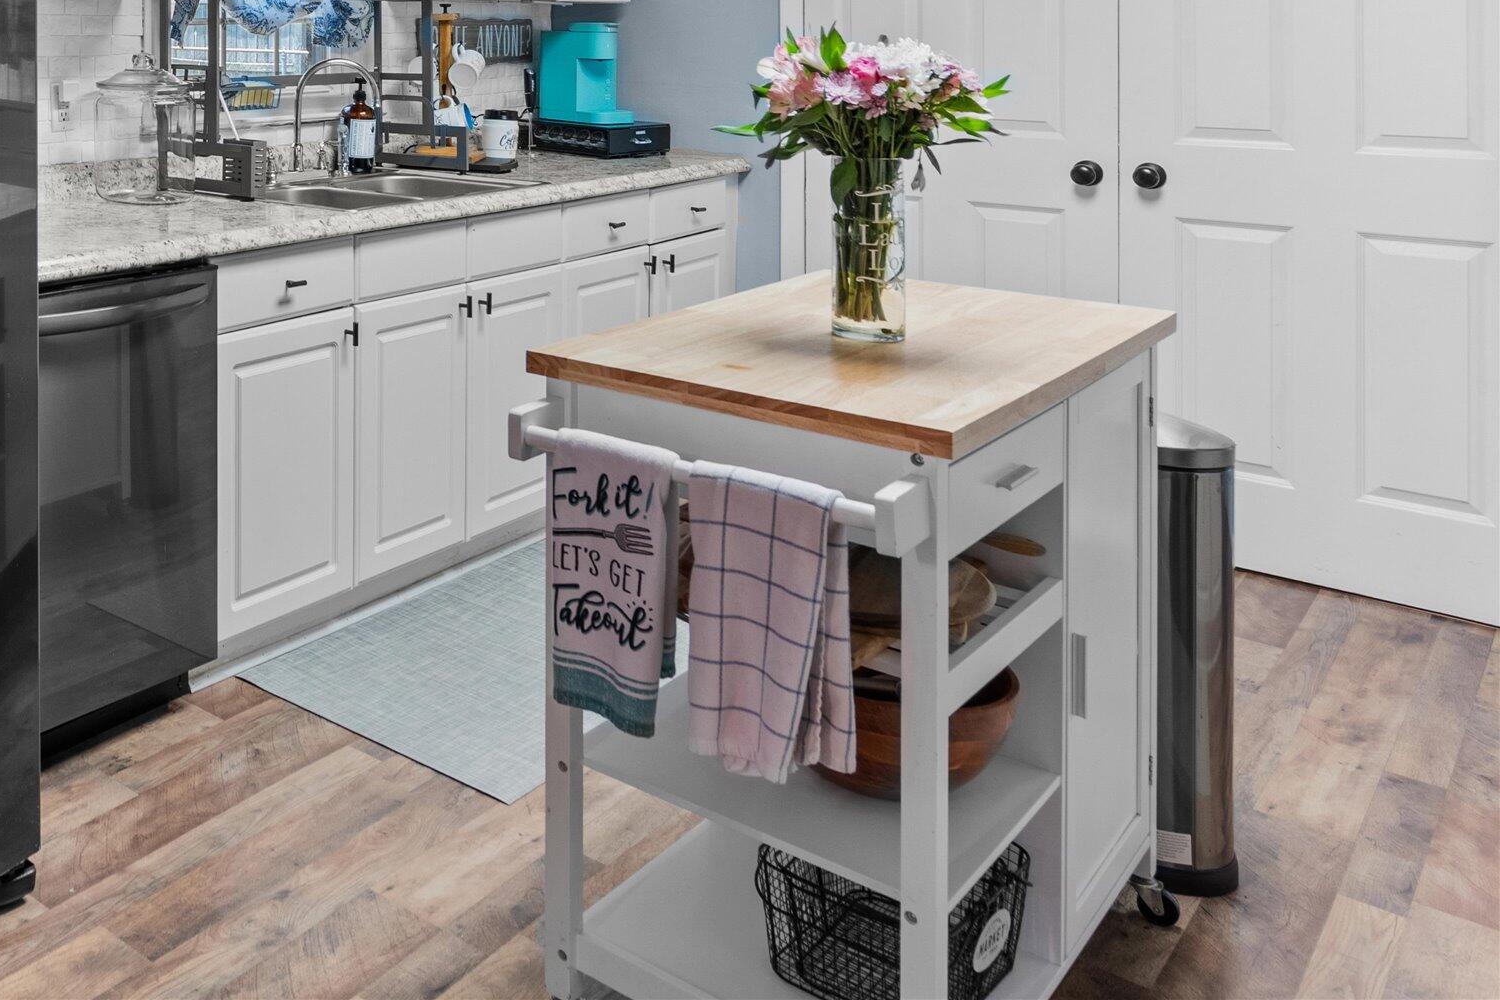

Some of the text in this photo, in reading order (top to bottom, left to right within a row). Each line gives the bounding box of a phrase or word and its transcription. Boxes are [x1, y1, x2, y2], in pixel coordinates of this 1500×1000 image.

[476, 25, 532, 57] ANYONE?
[553, 467, 655, 520] Fork it!
[553, 541, 646, 598] LET'S GET
[552, 583, 654, 651] Takeout
